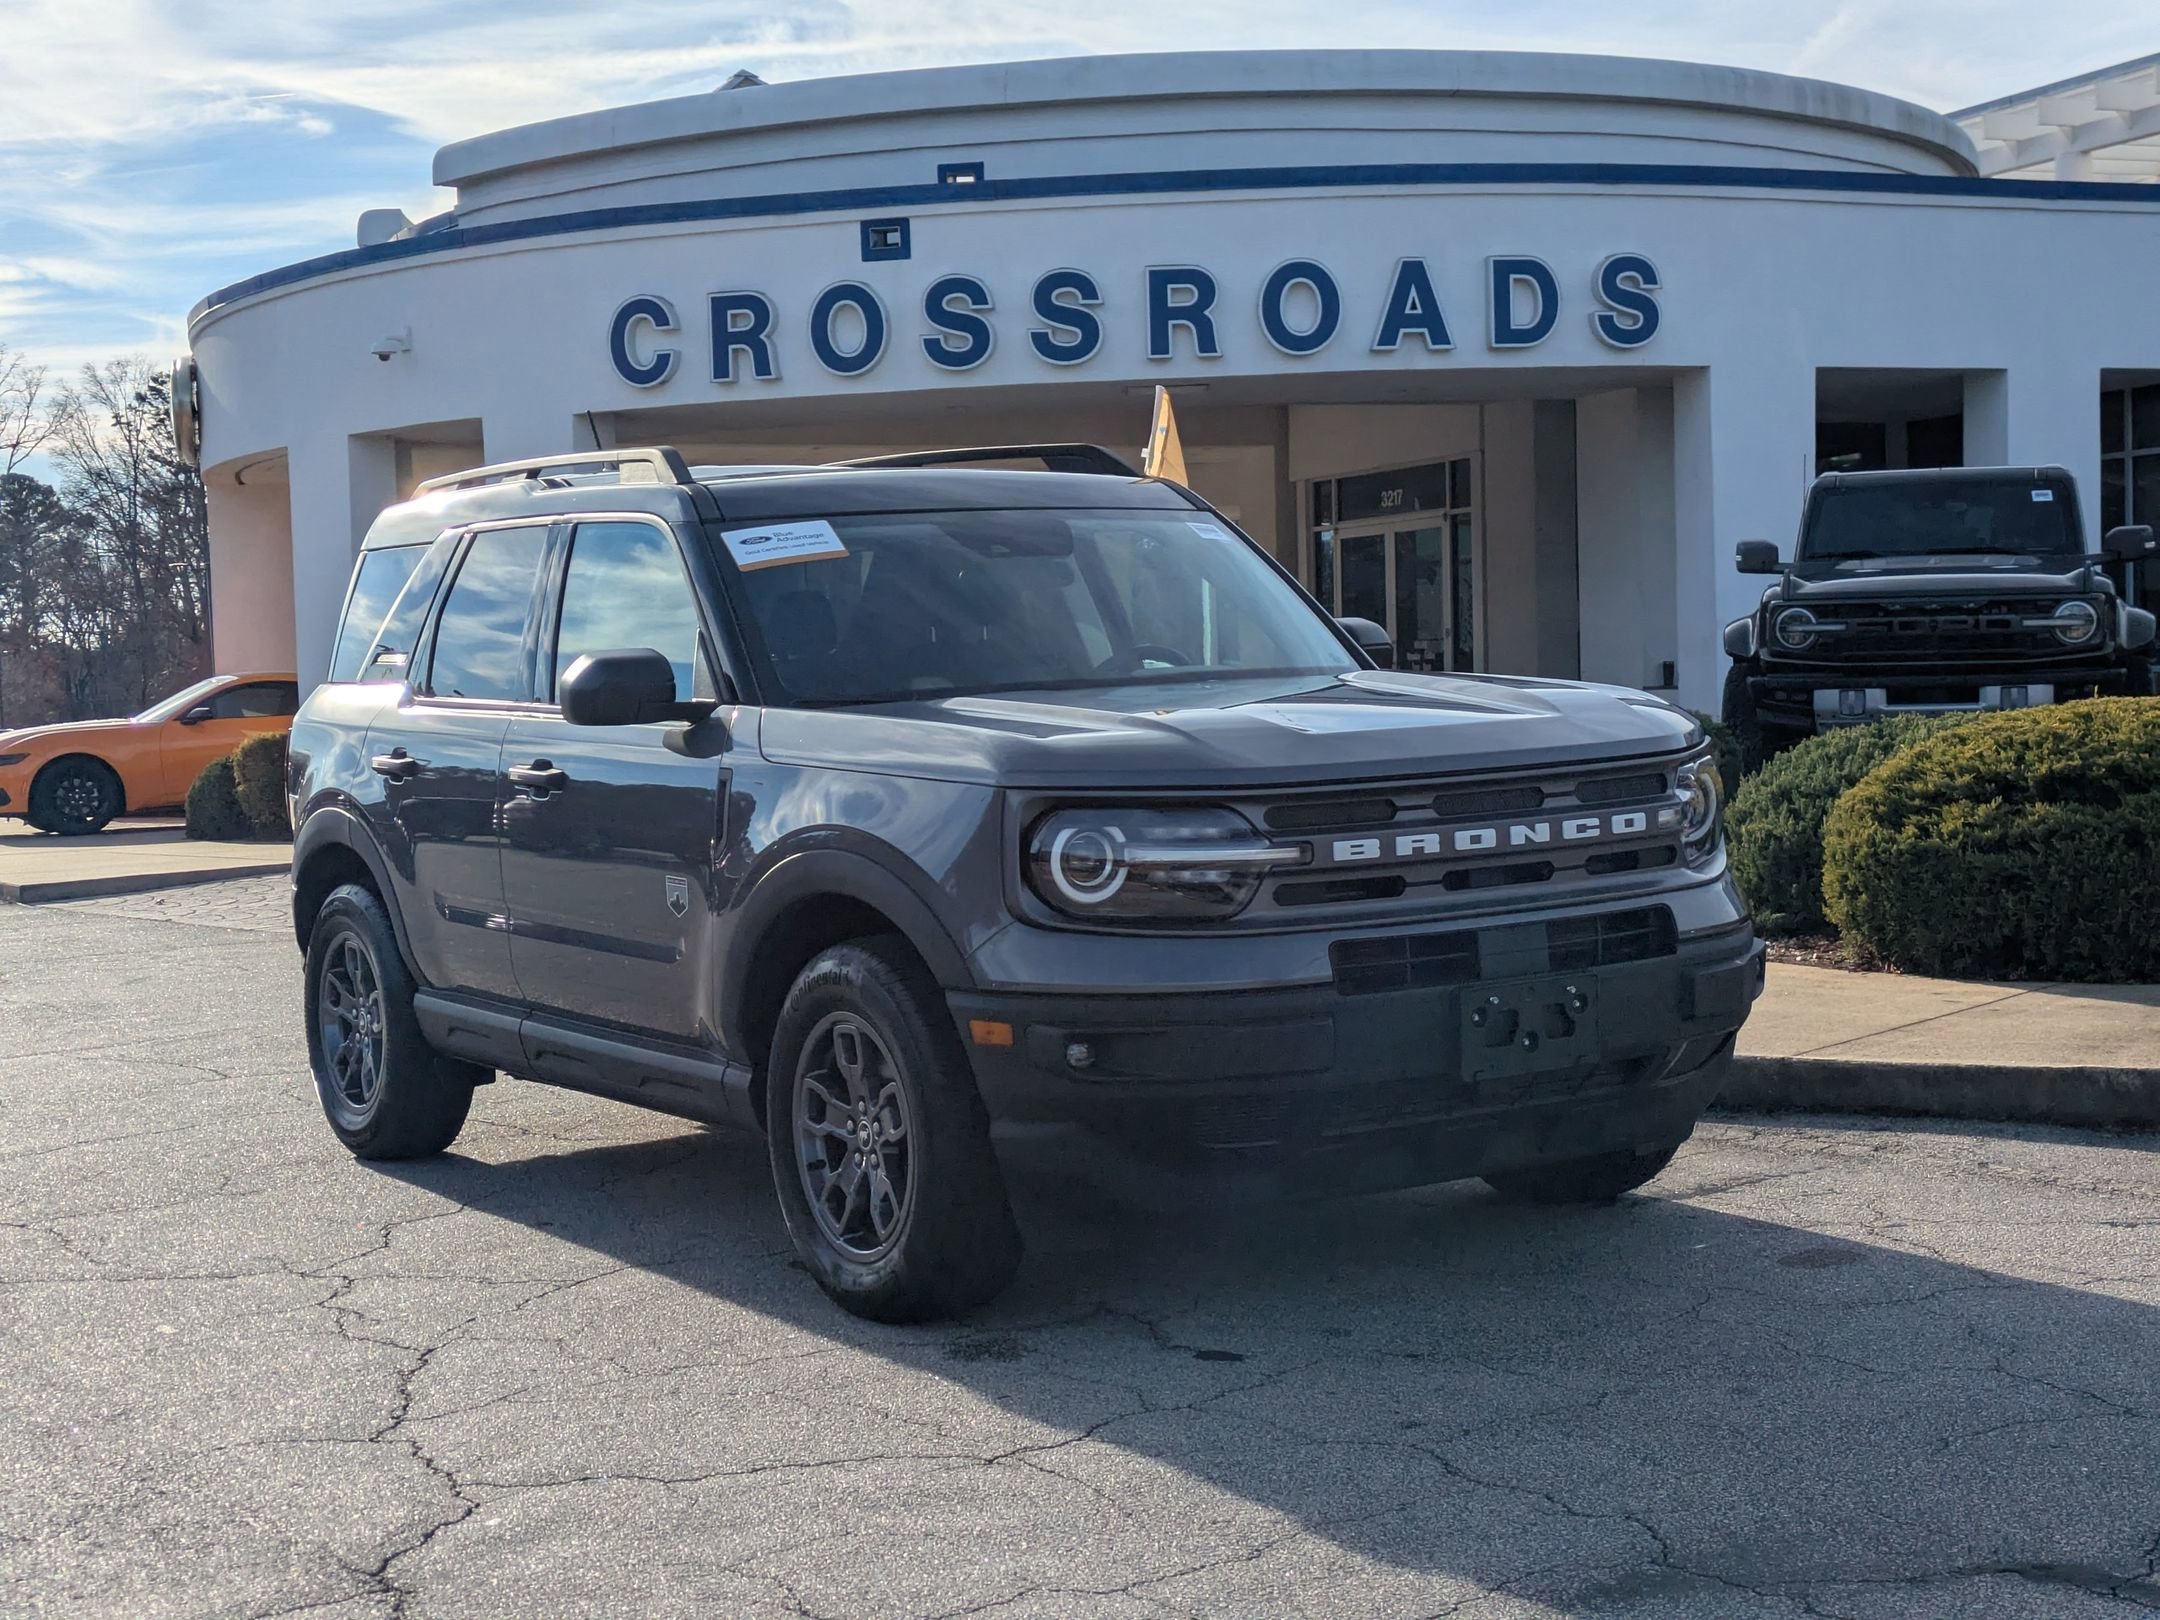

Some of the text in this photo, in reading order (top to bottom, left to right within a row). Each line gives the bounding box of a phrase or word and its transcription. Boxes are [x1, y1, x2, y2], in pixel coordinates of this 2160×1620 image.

[609, 253, 1664, 388] CROSSROADS
[1380, 489, 1403, 507] 3217
[777, 533, 825, 543] Advantage
[1333, 812, 1646, 861] BRONCO
